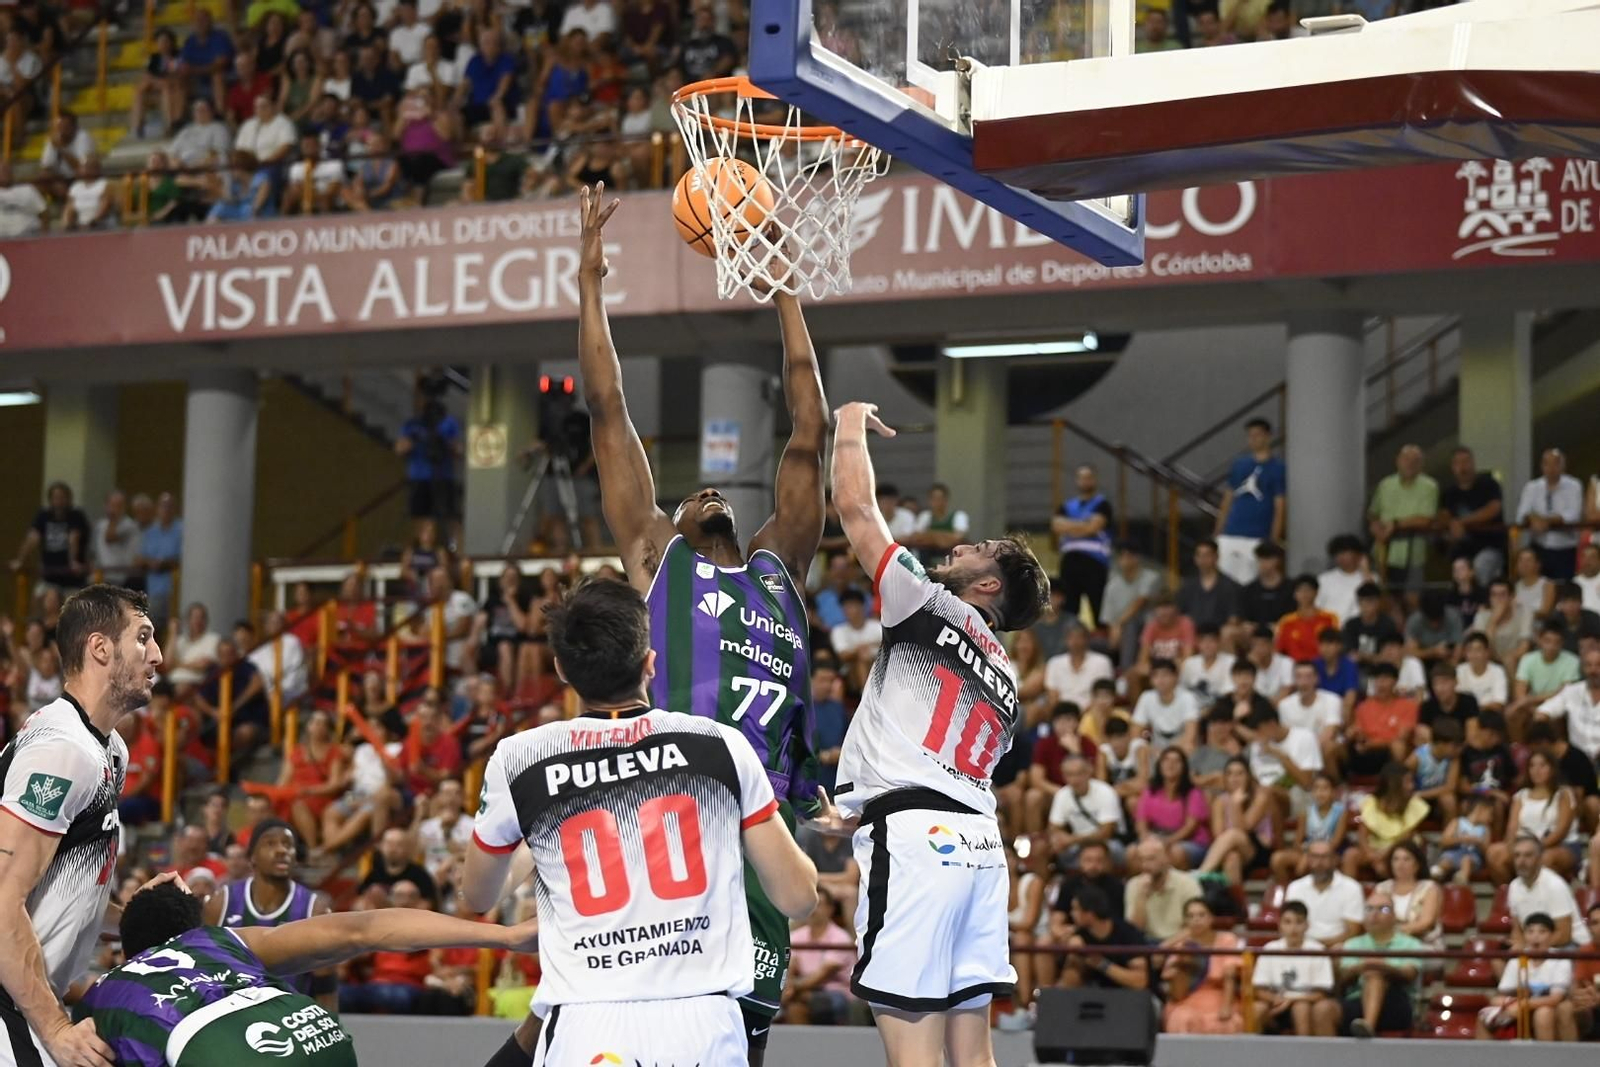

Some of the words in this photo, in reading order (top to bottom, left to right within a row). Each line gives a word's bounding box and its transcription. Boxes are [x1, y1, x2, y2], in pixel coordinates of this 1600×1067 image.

[186, 230, 299, 262] PALACIO
[304, 221, 447, 254] MUNICIPAL
[453, 208, 582, 244] DEPORTES
[1561, 198, 1594, 233] DE
[893, 263, 1001, 294] Municipal
[1006, 262, 1038, 286] de
[1151, 251, 1254, 277] Córdoba
[157, 264, 338, 333] VISTA
[740, 606, 804, 650] Unicaja
[720, 638, 793, 678] málaga
[936, 625, 1017, 717] PULEVA
[731, 676, 787, 726] 77
[922, 664, 1003, 779] 10
[545, 743, 688, 796] PULEVA
[560, 793, 707, 917] 00
[574, 915, 711, 950] AYUNTAMIENTO
[587, 954, 612, 969] DE
[617, 939, 703, 967] GRANADA
[281, 1004, 328, 1029] COSTA
[292, 1023, 322, 1042] DEL
[317, 1016, 338, 1031] SOL
[302, 1029, 346, 1056] MÁLAGA
